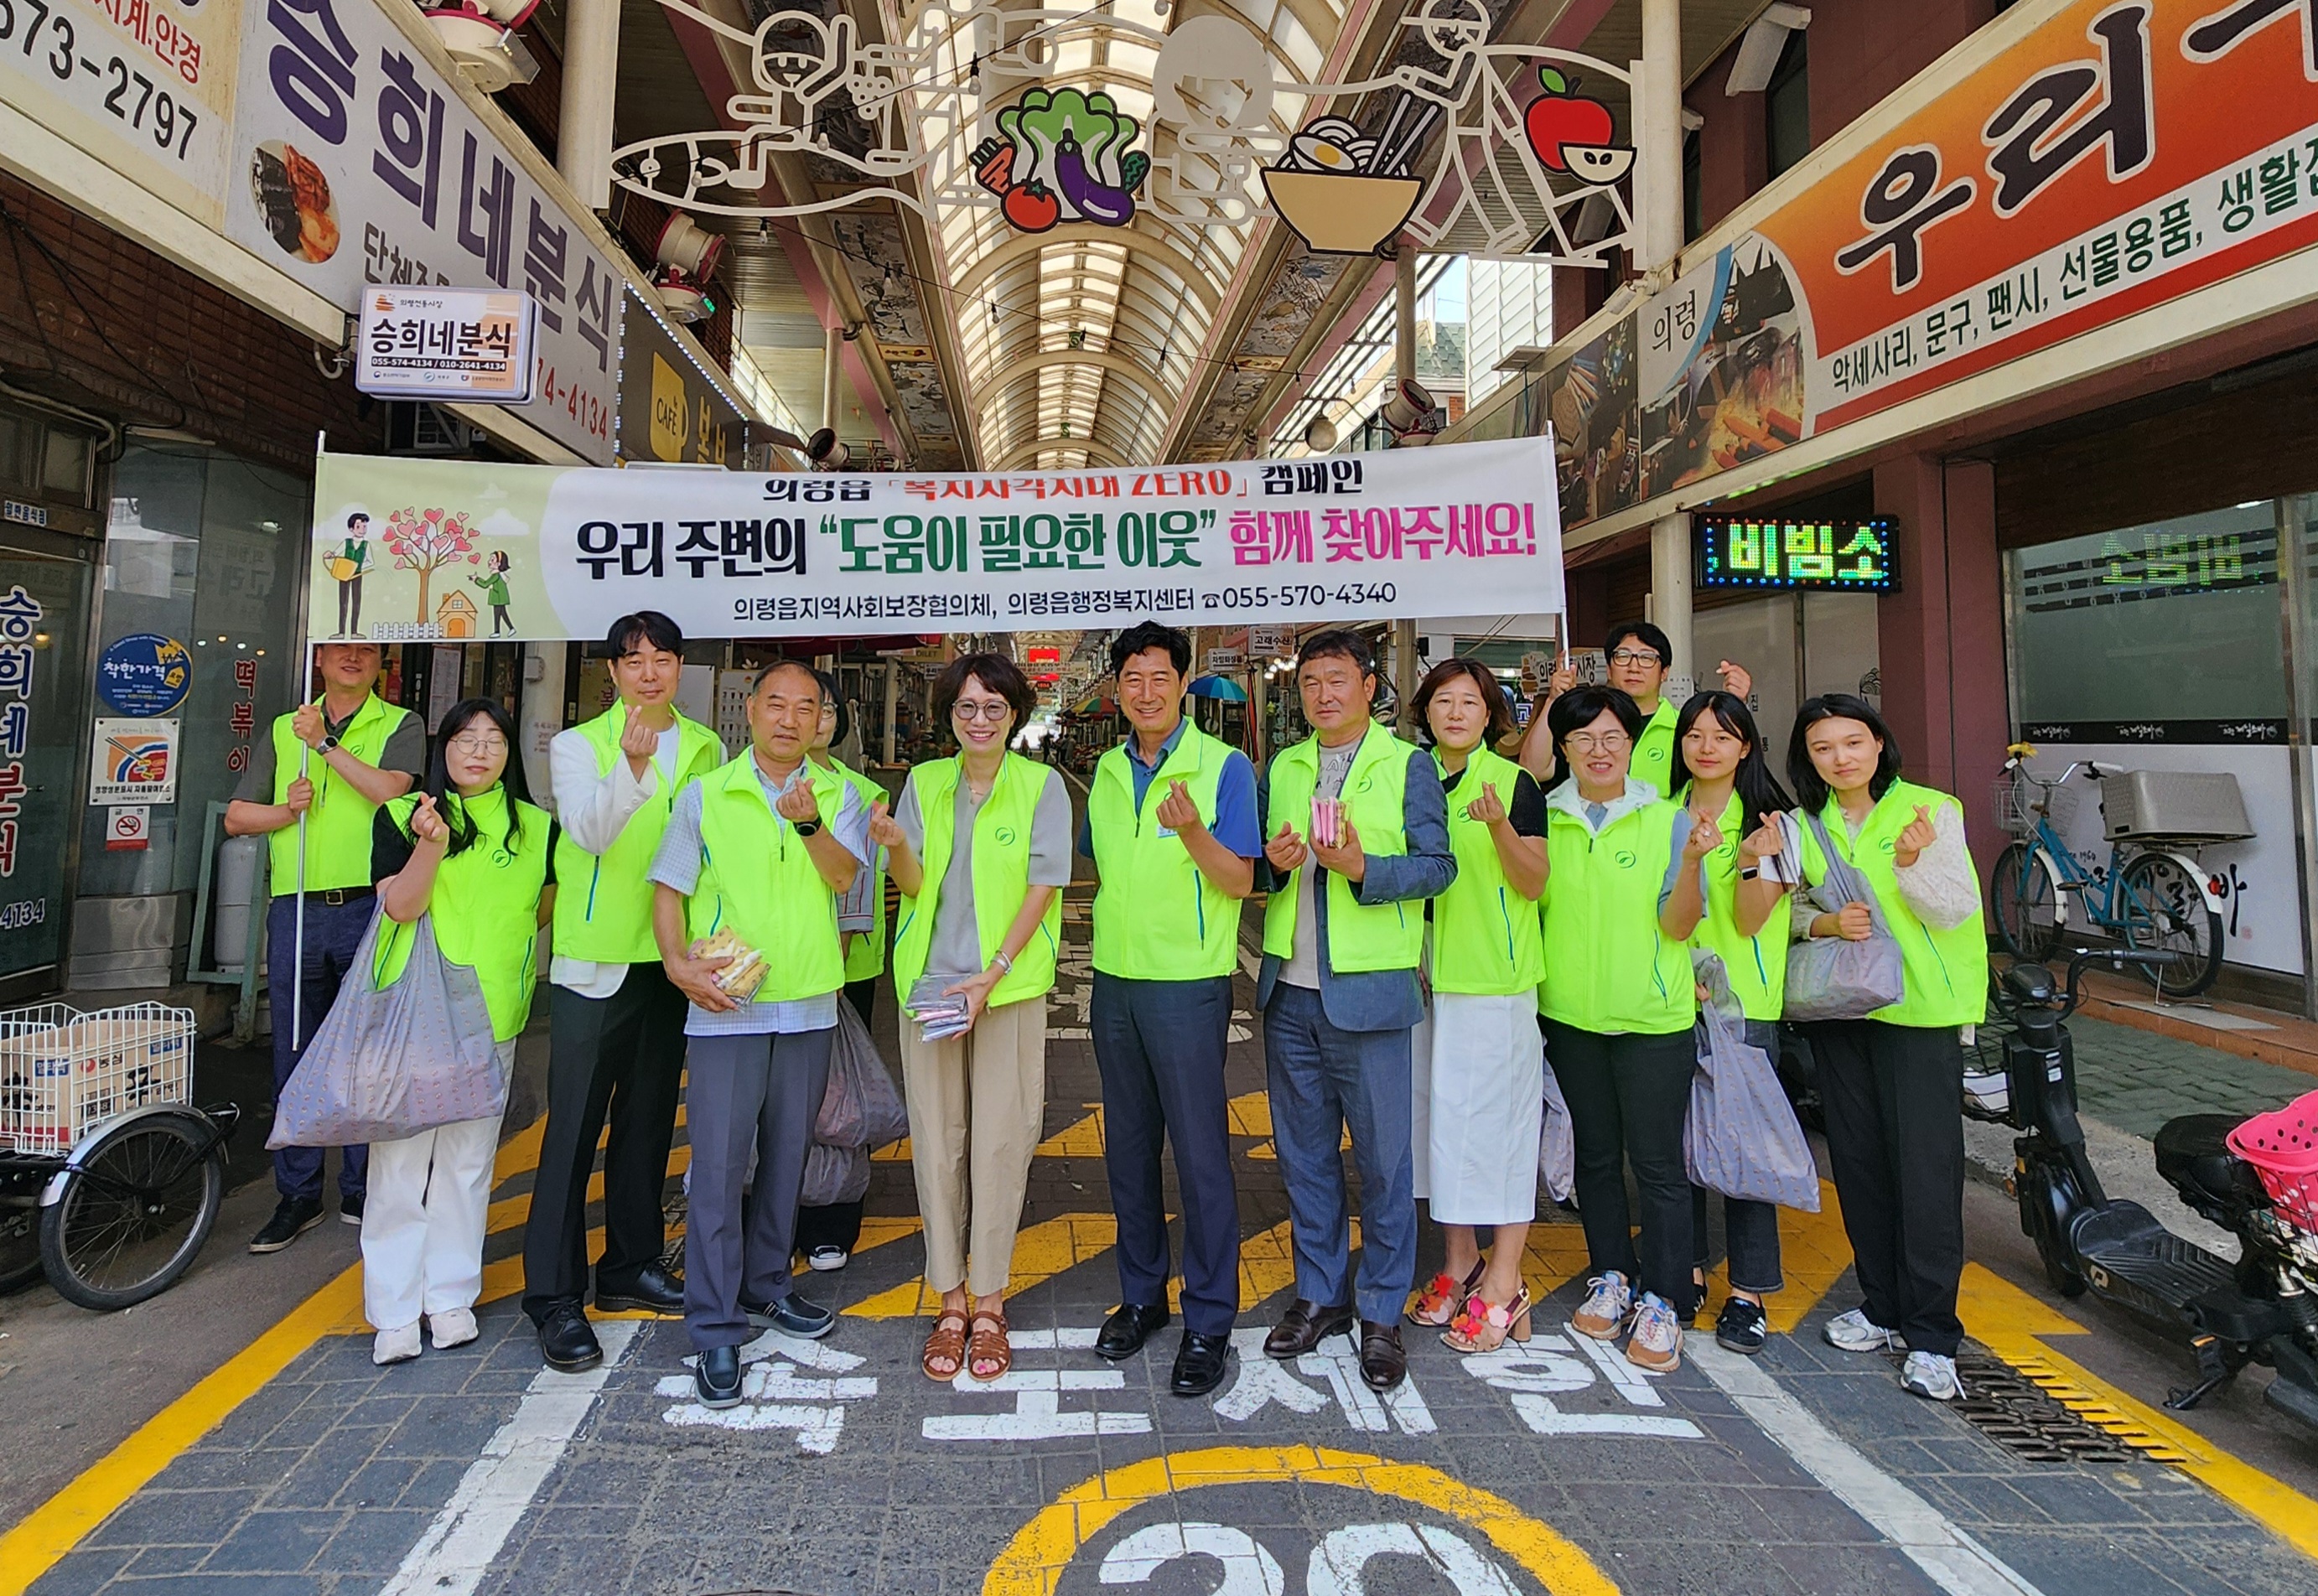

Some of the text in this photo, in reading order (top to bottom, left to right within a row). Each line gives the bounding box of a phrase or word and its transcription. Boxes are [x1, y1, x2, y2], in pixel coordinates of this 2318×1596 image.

[1833, 325, 1918, 393] 악세사리,
[1926, 298, 1978, 358] 문구,
[2060, 198, 2203, 301] 선물용품,
[371, 318, 512, 358] 승희네분식
[1652, 289, 1696, 352] 의령
[371, 358, 433, 369] 055-574-4134
[439, 361, 506, 371] 010-2641-4134
[762, 478, 873, 503] 의령읍
[1259, 459, 1364, 496] 캠페인
[575, 502, 1536, 579] 우리 주변의 “도움이 필요한 이웃” 함께 찾아주세요!
[1729, 523, 1884, 579] 비빔소
[1007, 588, 1195, 617] 의령읍행정복지센터
[1254, 635, 1292, 646] 고래수산
[103, 656, 166, 681] 착한가격
[227, 659, 257, 775] 떡볶이
